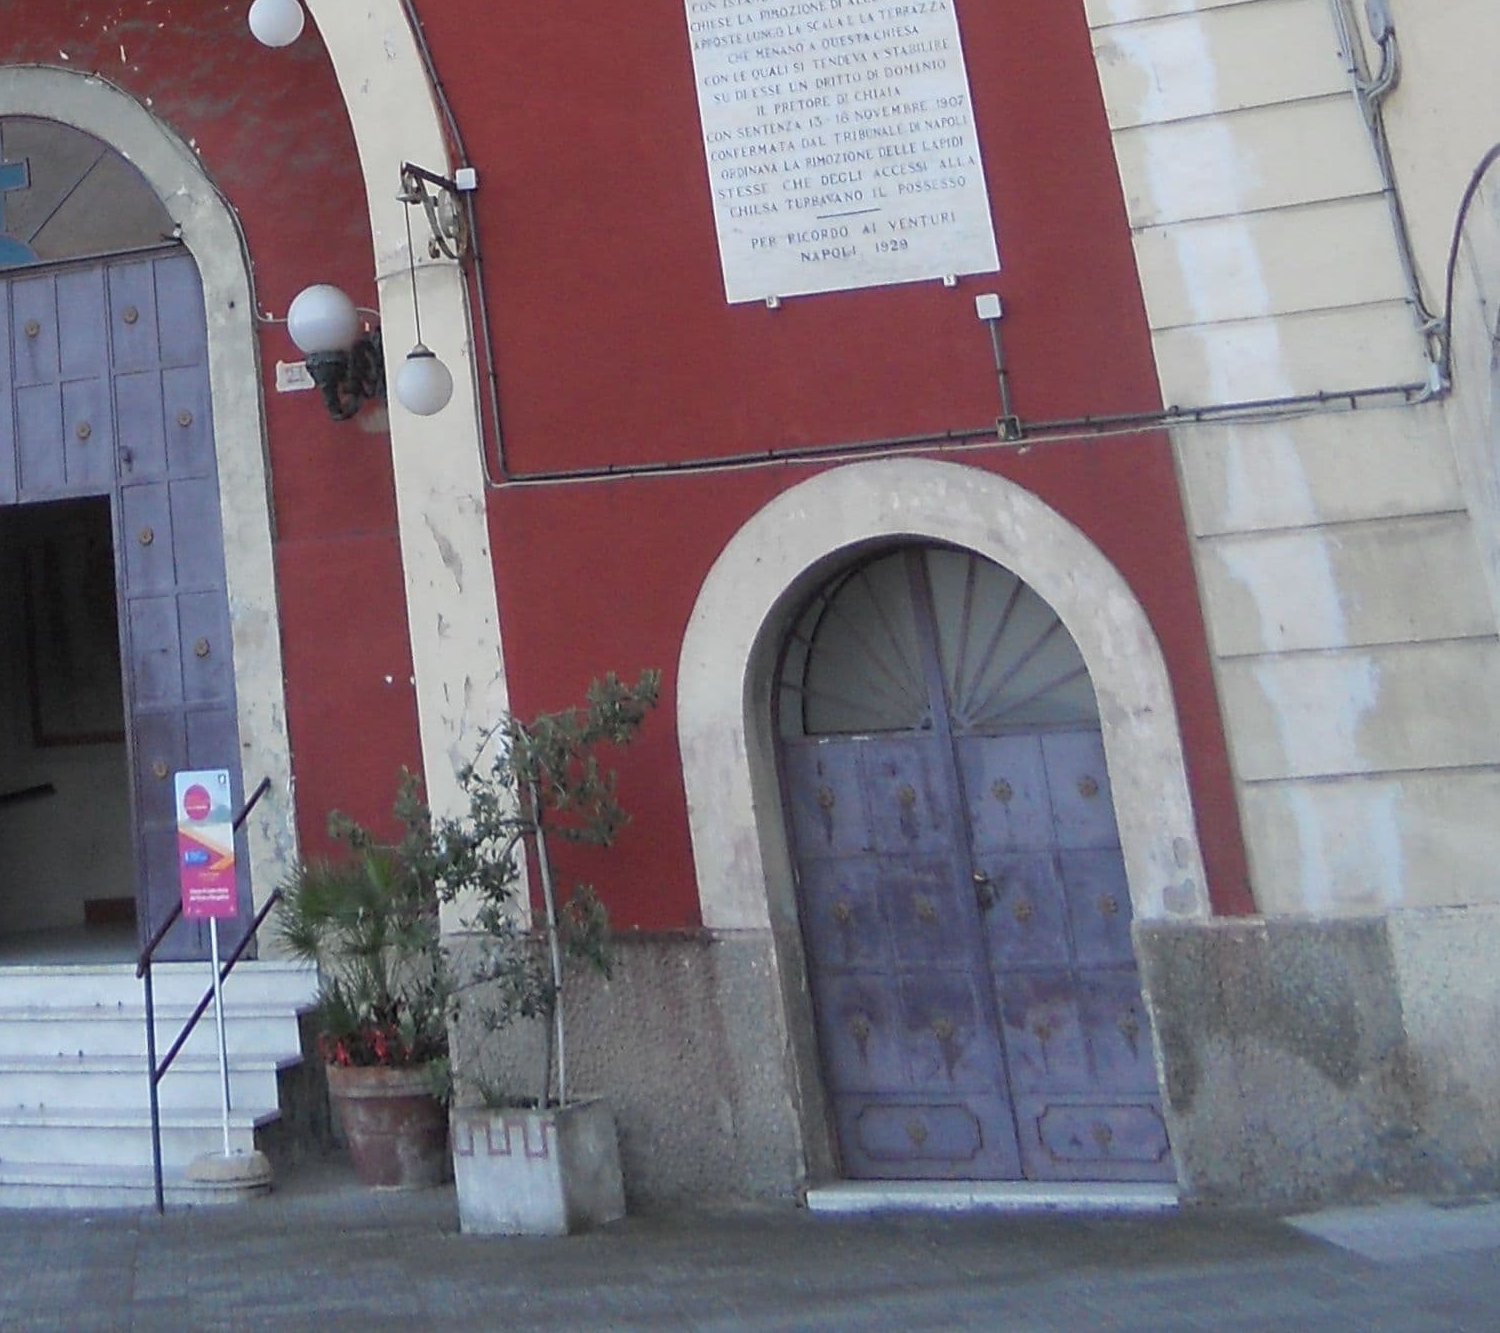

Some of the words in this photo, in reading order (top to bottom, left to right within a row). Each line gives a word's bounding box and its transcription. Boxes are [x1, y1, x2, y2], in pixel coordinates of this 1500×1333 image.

[738, 13, 752, 25] LA
[787, 24, 801, 34] LA
[859, 12, 873, 22] LA
[756, 43, 804, 59] MENANO
[821, 32, 869, 48] QUESTA
[704, 75, 728, 87] CON
[751, 65, 788, 80] QUALI
[793, 62, 804, 73] SI
[812, 52, 866, 70] TENDEVA
[789, 80, 807, 92] UN
[774, 96, 829, 114] PRETORE
[706, 131, 731, 143] CON
[737, 120, 801, 139] SENTENZA
[854, 101, 927, 121] NOVEMBRE
[801, 136, 825, 148] DAL
[908, 122, 920, 132] DI
[783, 160, 799, 171] LA
[878, 142, 917, 157] DELLE
[922, 136, 963, 151] LAPIDI
[782, 177, 811, 191] CHE
[820, 170, 862, 185] DEGLI
[873, 161, 927, 178] ACCESSI
[938, 154, 975, 169] ALLA
[872, 187, 886, 198] IL
[897, 175, 966, 194] POSSESSO
[750, 236, 776, 249] PER
[861, 222, 876, 234] AI
[888, 212, 956, 230] VENTURI
[800, 246, 856, 262] NAPOLI
